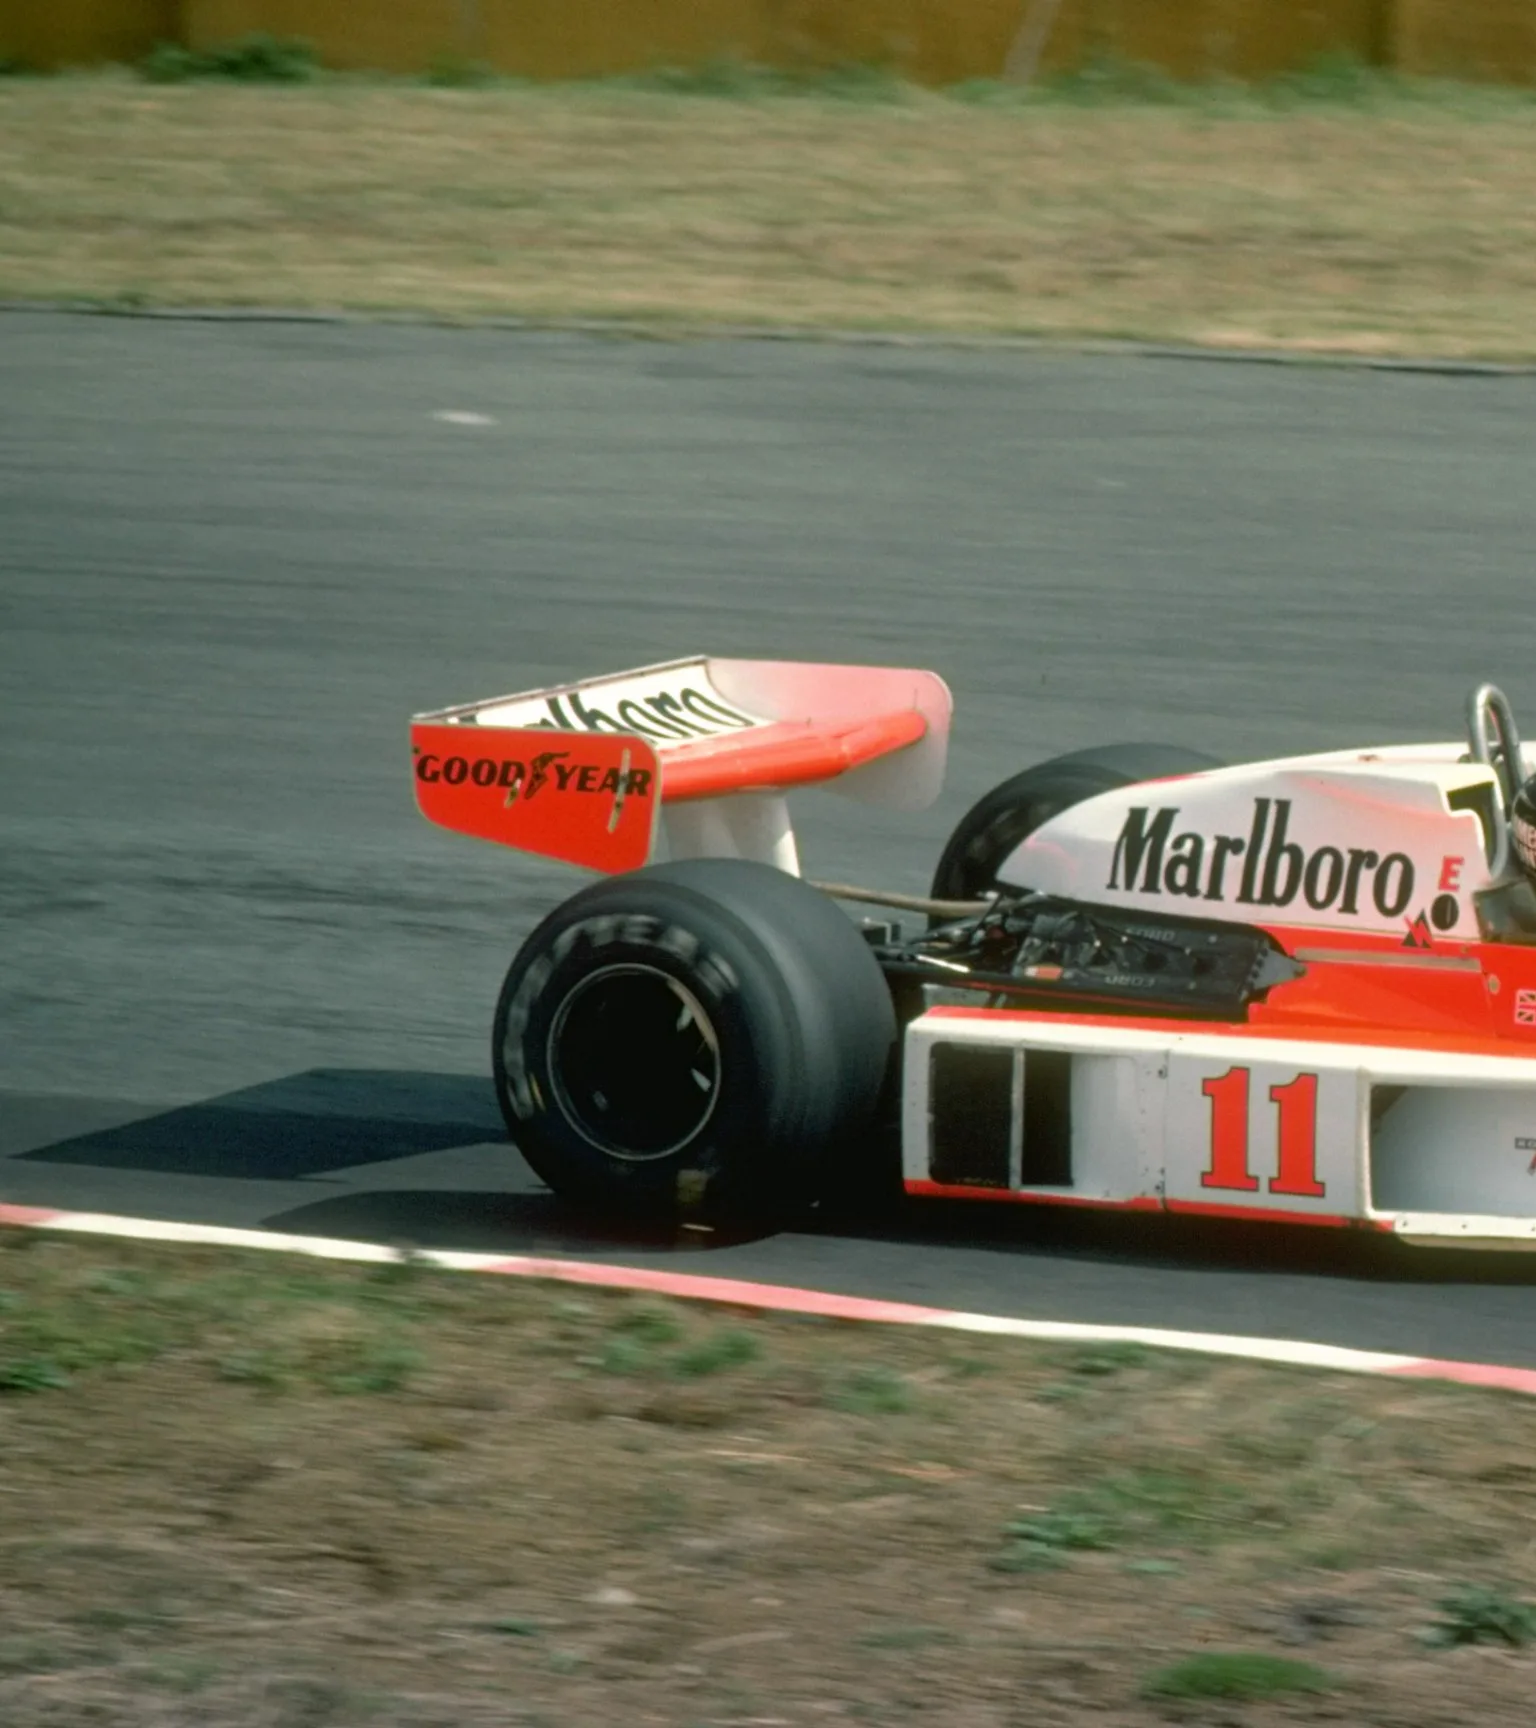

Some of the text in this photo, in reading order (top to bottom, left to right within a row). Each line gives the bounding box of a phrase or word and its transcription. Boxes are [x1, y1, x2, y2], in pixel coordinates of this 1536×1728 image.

[458, 688, 754, 744] lboro
[1106, 797, 1415, 917] Marlboro
[1438, 855, 1465, 892] E
[1200, 1066, 1326, 1198] 11
